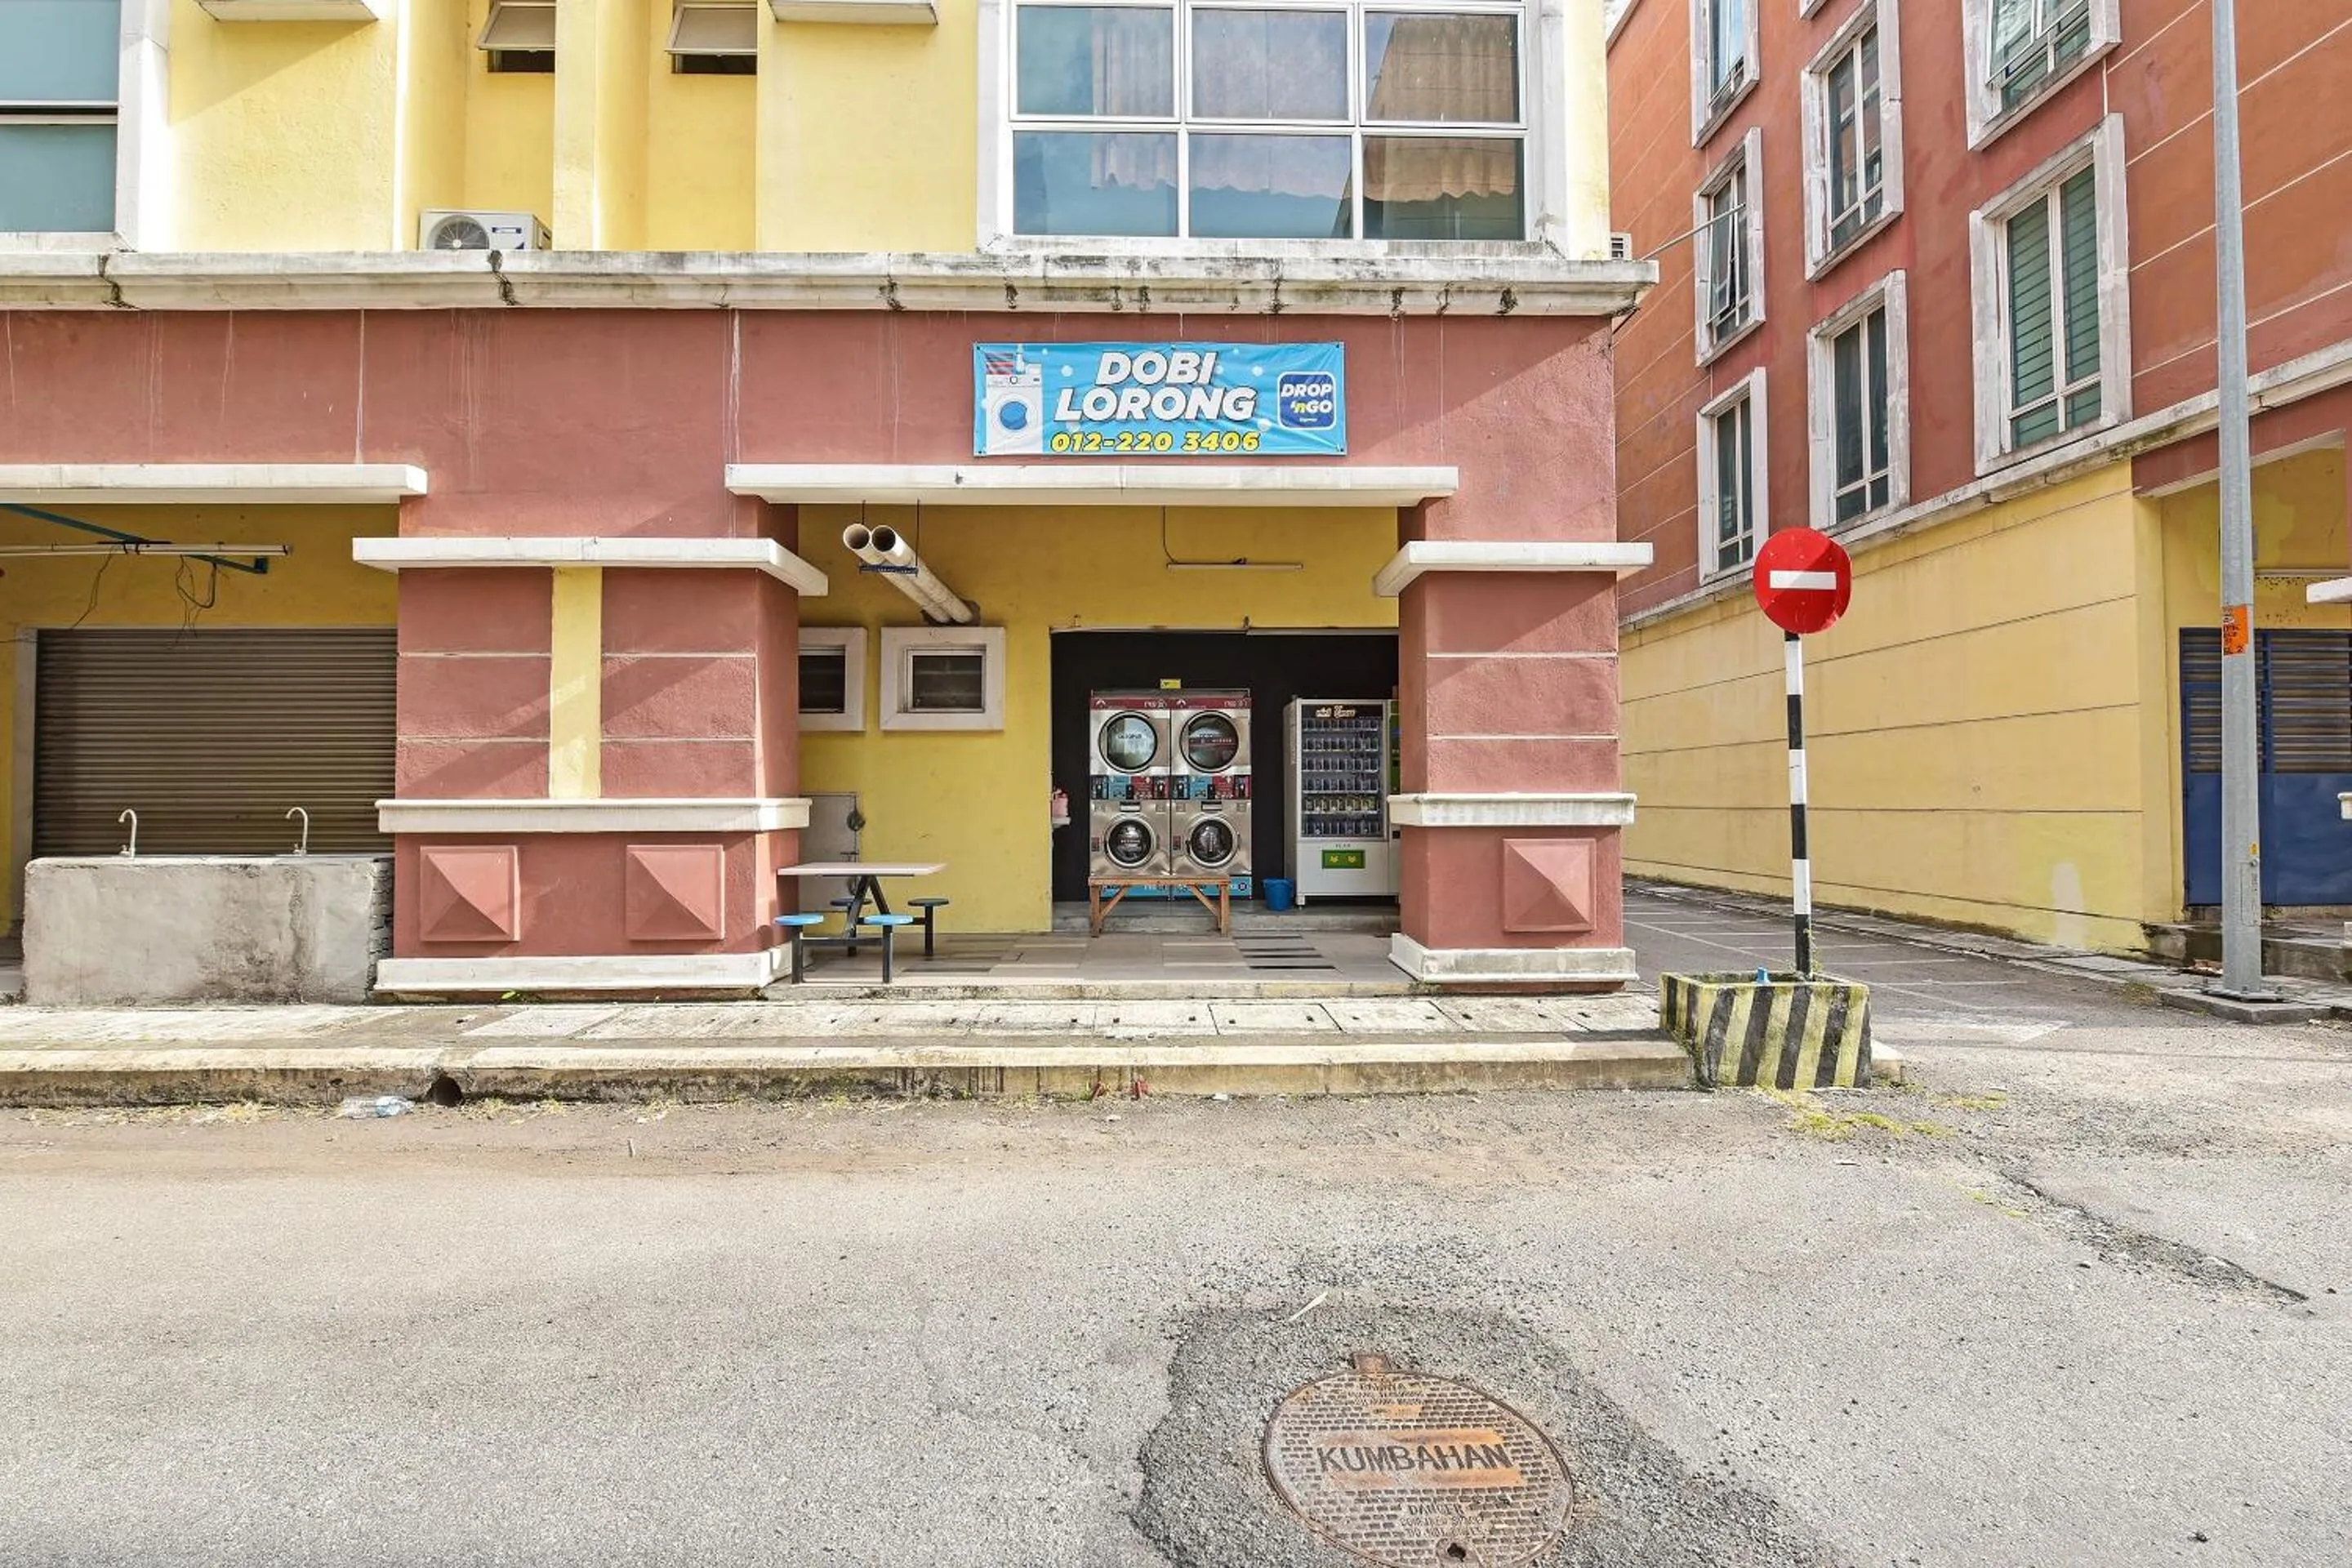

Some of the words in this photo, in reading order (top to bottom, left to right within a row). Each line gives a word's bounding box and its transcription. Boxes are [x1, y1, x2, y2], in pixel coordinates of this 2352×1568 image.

[1095, 351, 1217, 386] DOBI
[1281, 383, 1332, 398] DROP
[1054, 386, 1258, 422] LORONG
[1050, 432, 1173, 452] 012-220
[1181, 431, 1260, 452] 3406
[1316, 1443, 1515, 1472] KUMBAHAN
[1407, 1503, 1465, 1516] DANGER
